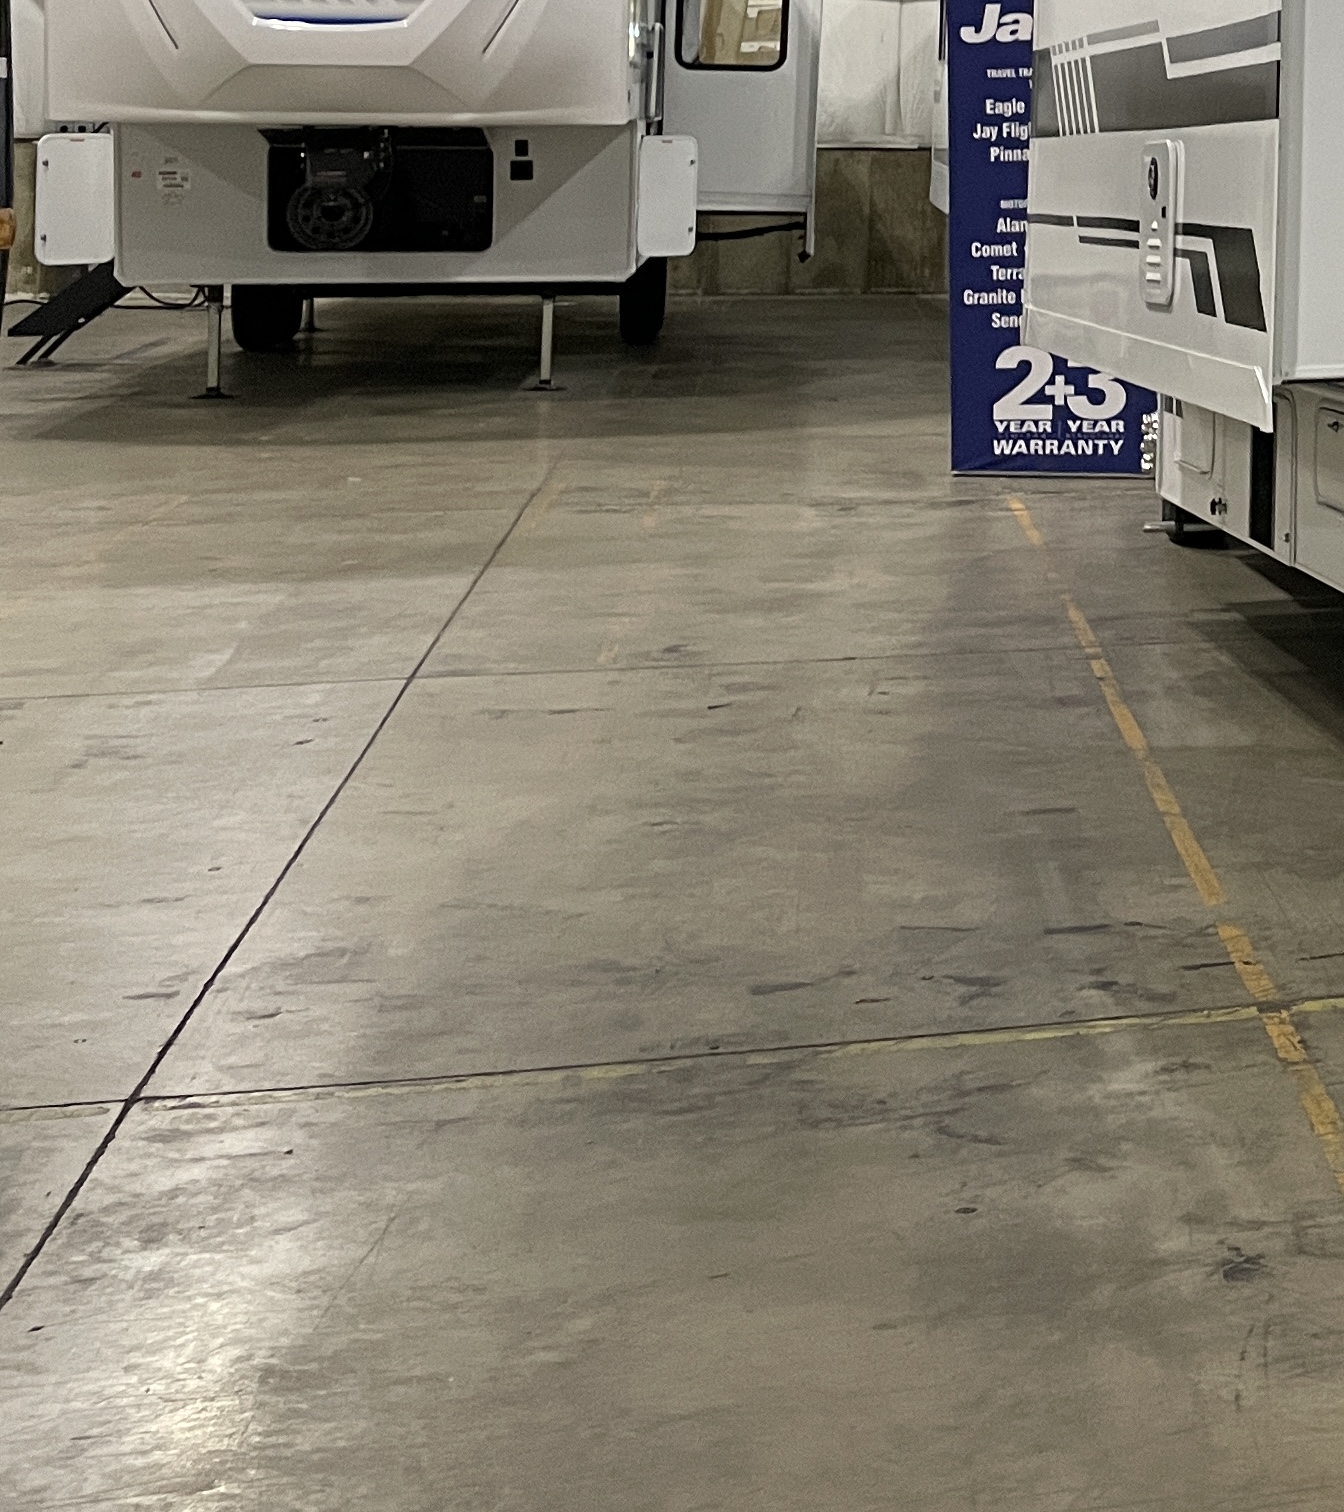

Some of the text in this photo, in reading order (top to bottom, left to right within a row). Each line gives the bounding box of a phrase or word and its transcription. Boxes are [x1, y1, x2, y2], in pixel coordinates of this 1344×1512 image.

[959, 2, 1034, 44] Ja
[985, 98, 1026, 118] Eagle
[972, 122, 998, 142] Jay
[971, 241, 1018, 258] Comet
[963, 288, 1016, 305] Granite
[993, 419, 1125, 433] YEAR YEAR
[993, 439, 1124, 456] WARRANTY
